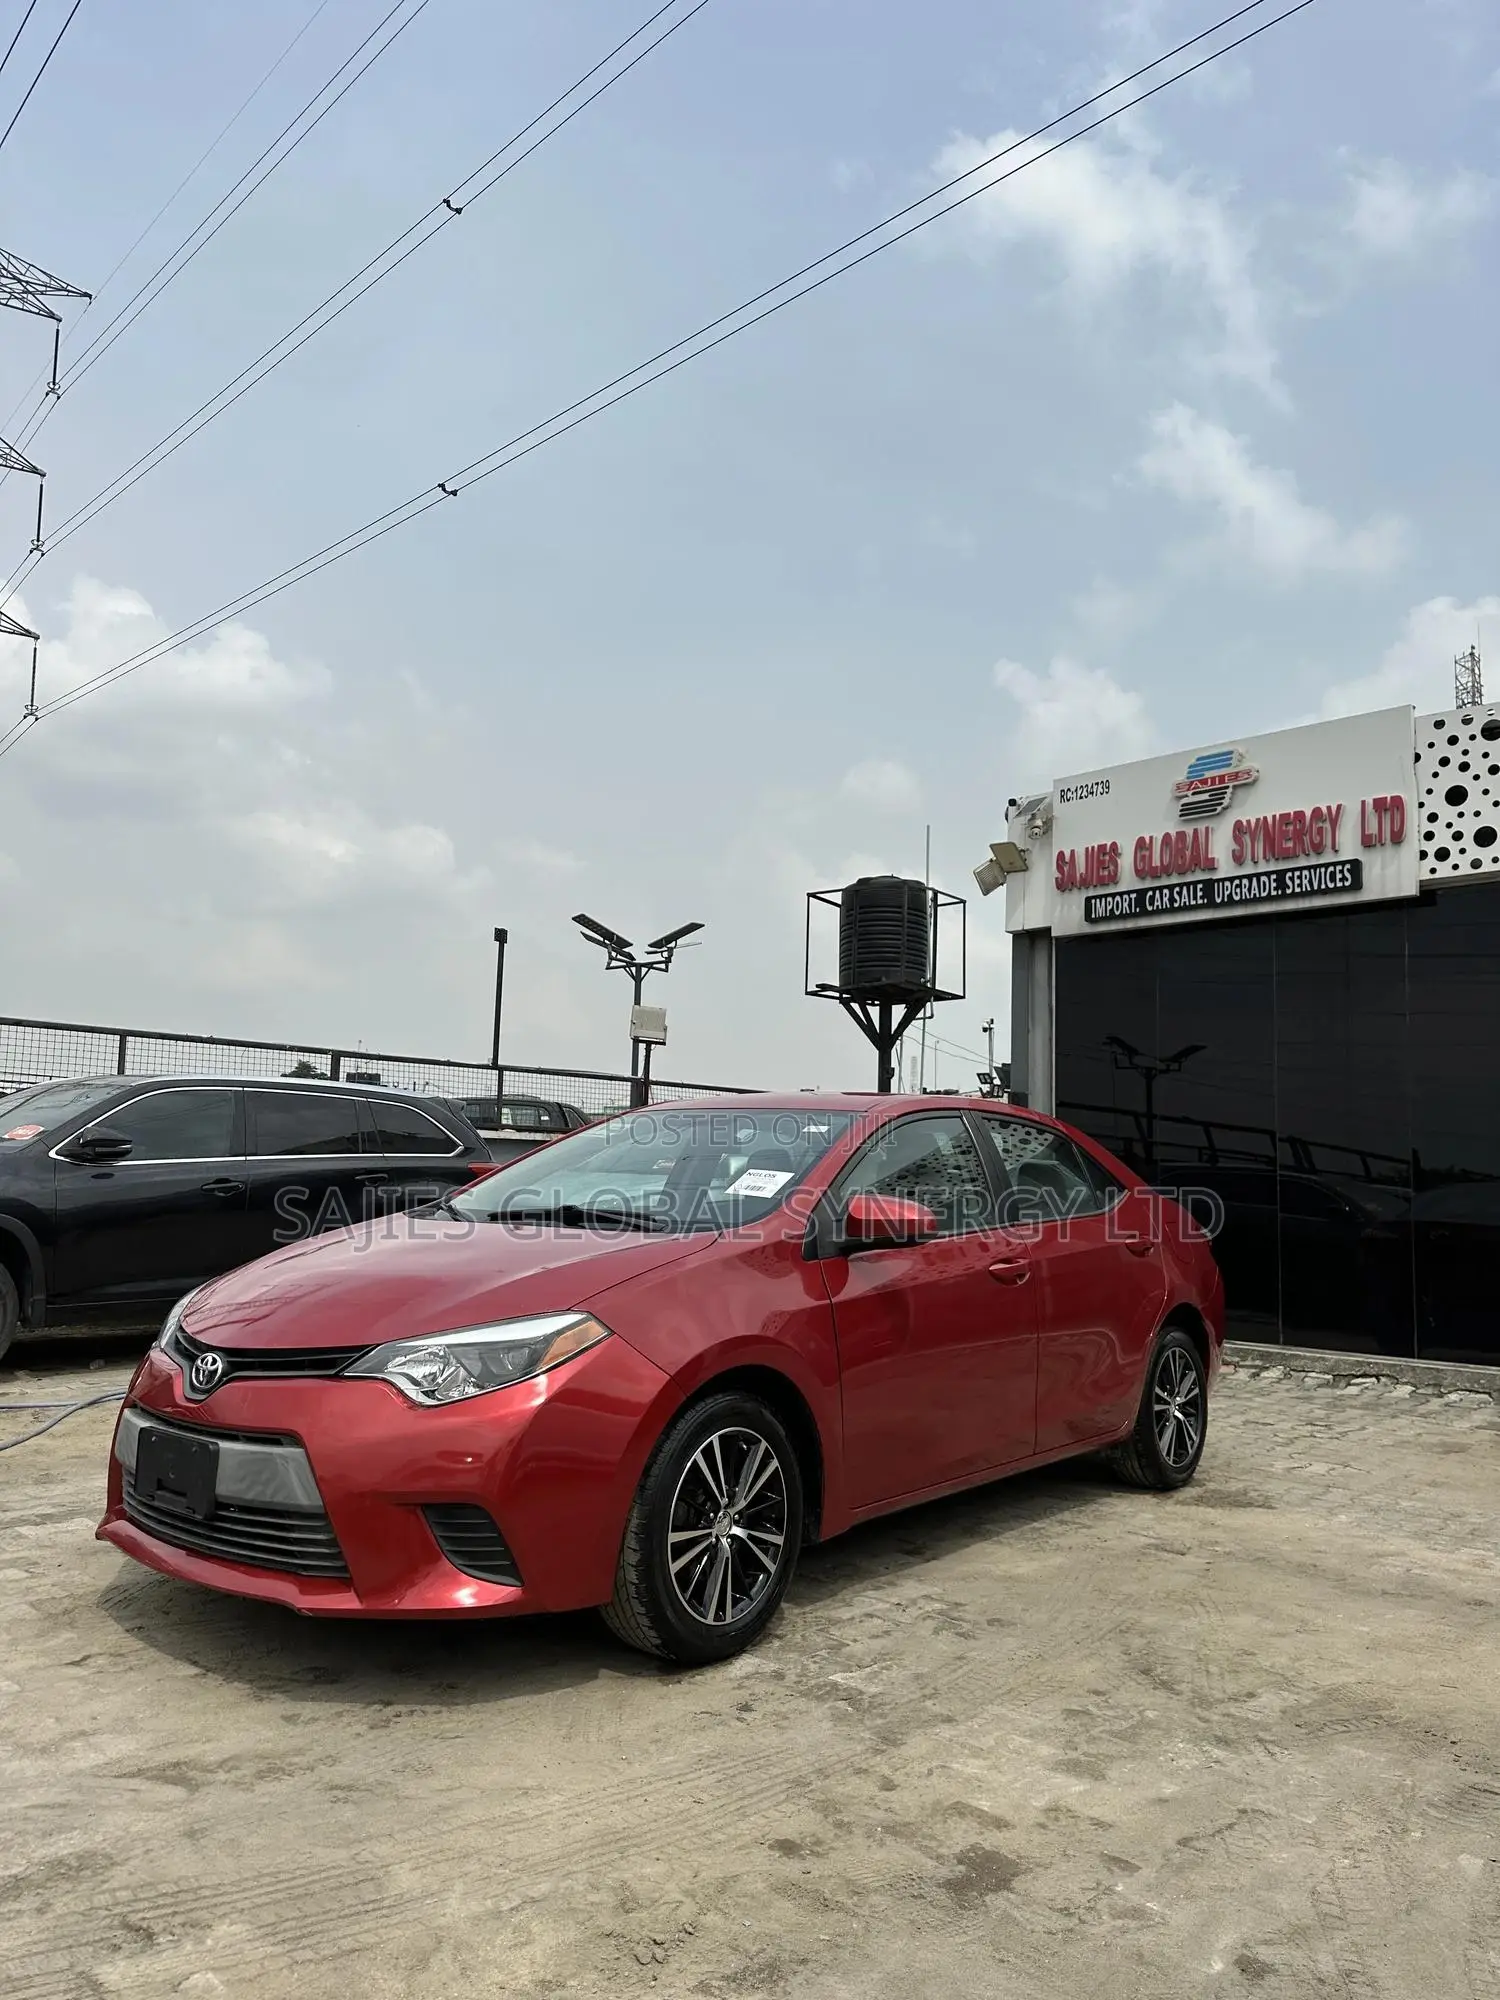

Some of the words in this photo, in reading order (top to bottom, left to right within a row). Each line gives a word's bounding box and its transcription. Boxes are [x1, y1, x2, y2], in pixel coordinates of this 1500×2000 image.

[1060, 779, 1110, 804] RC:1234739
[1175, 768, 1254, 794] SAJIES
[1055, 840, 1121, 892] SAJIES
[1133, 826, 1217, 879] GLOBAL
[1232, 804, 1343, 866] SYNERGY
[1360, 794, 1406, 848] LTD
[1091, 893, 1140, 919] IMPORT.
[1145, 890, 1170, 911] CAR
[1174, 883, 1207, 908] SALE.
[1214, 873, 1282, 903] UPGRADE.
[1285, 863, 1352, 894] SERVICES
